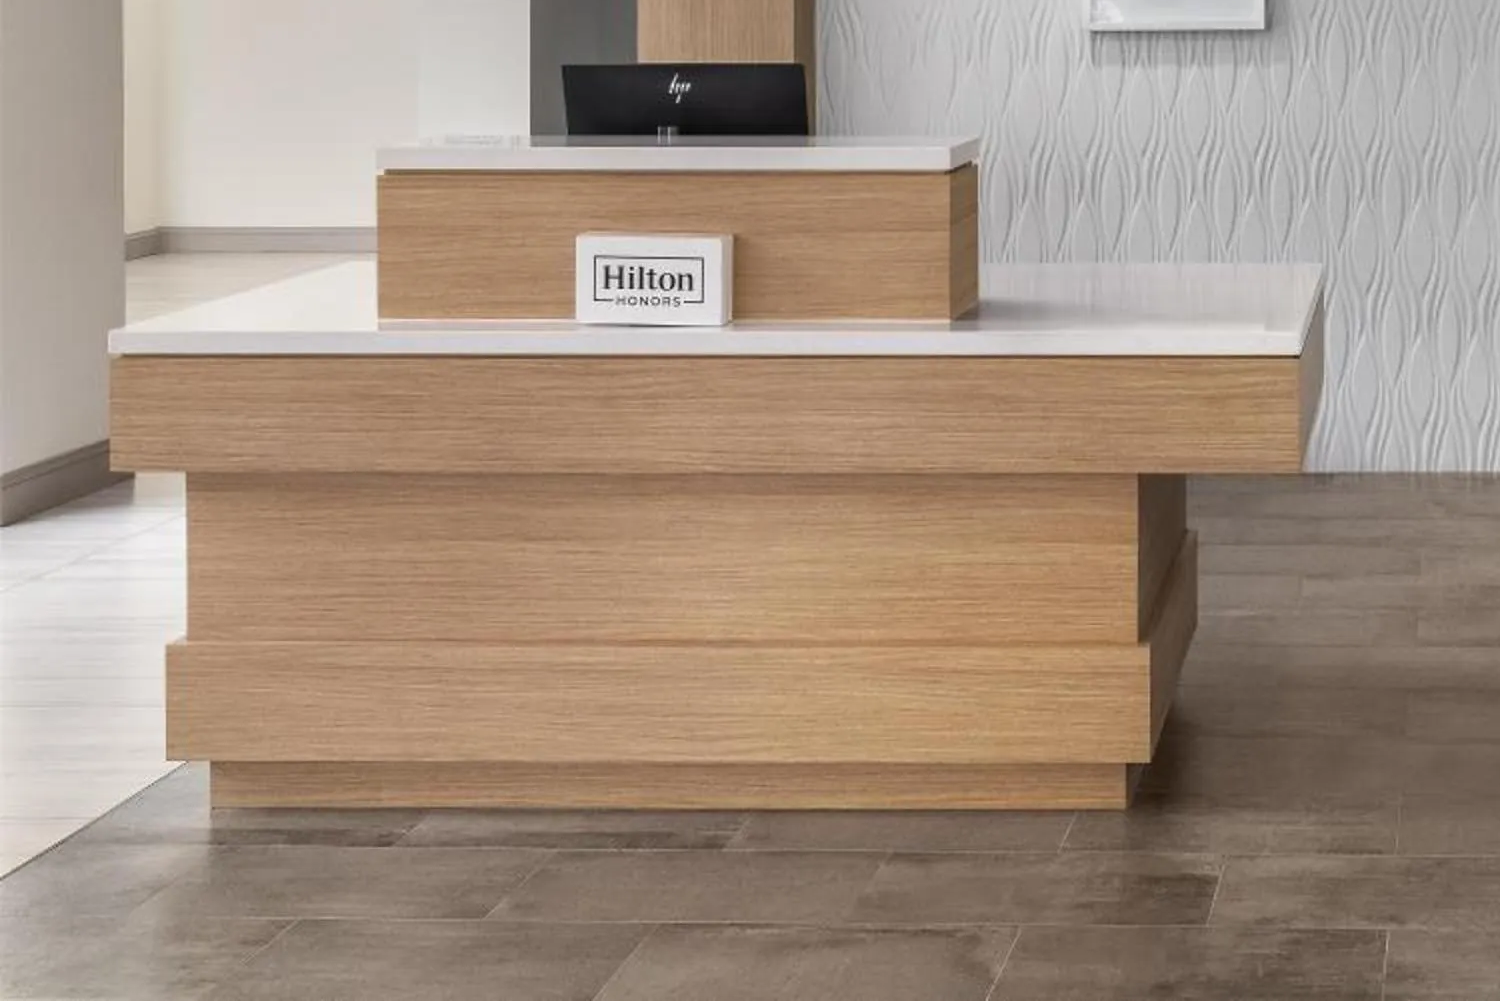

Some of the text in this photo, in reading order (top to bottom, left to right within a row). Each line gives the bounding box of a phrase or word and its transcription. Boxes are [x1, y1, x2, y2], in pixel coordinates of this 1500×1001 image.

[668, 71, 691, 104] hp
[602, 264, 695, 292] Hilton
[615, 296, 682, 308] HONORS
